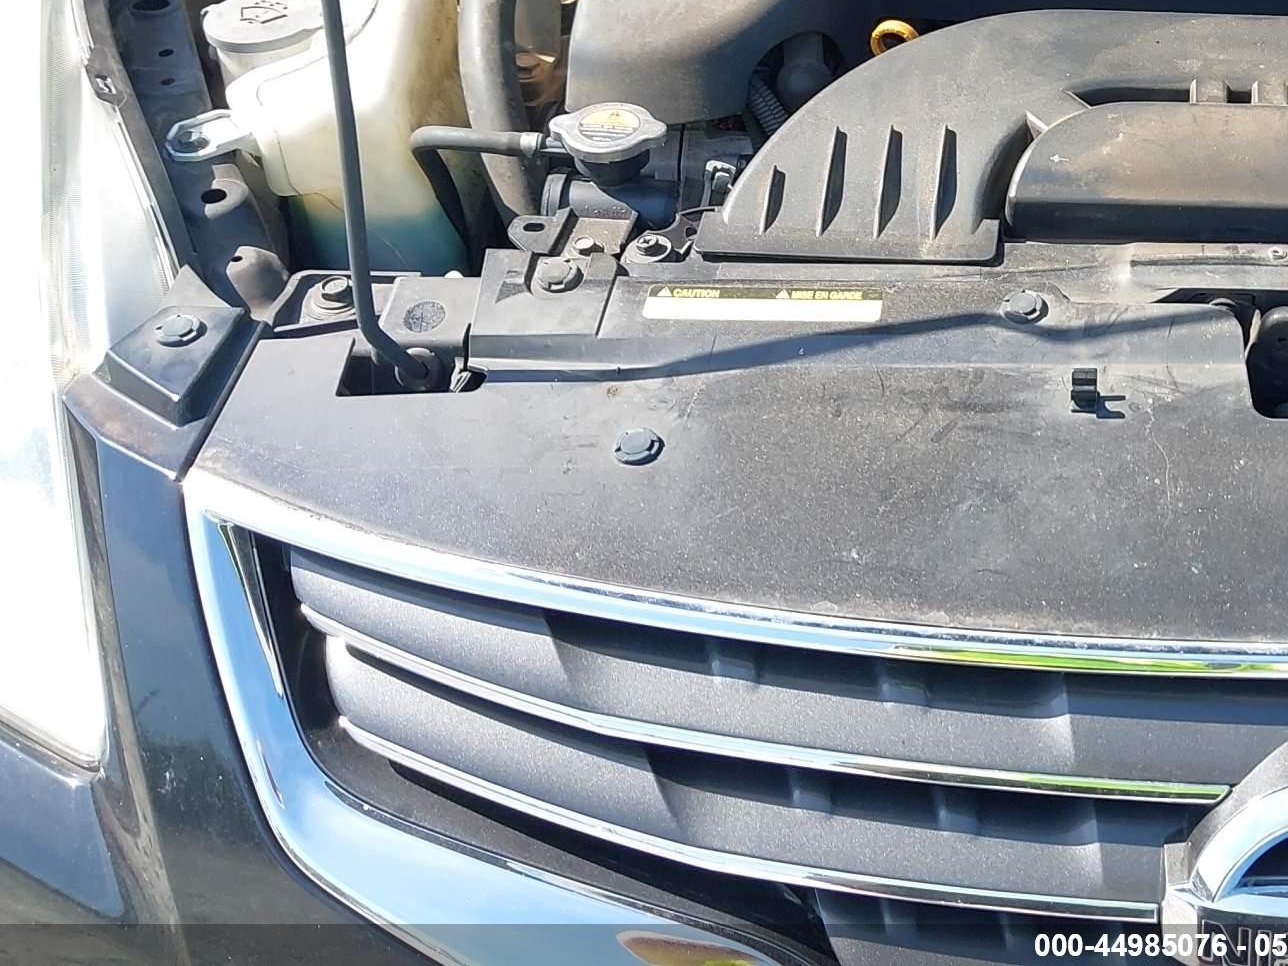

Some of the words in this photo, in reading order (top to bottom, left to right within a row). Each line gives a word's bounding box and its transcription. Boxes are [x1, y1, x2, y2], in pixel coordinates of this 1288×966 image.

[673, 288, 720, 298] CAUTION
[791, 290, 814, 300] MISE
[815, 291, 828, 300] EN
[829, 291, 863, 300] GARDE
